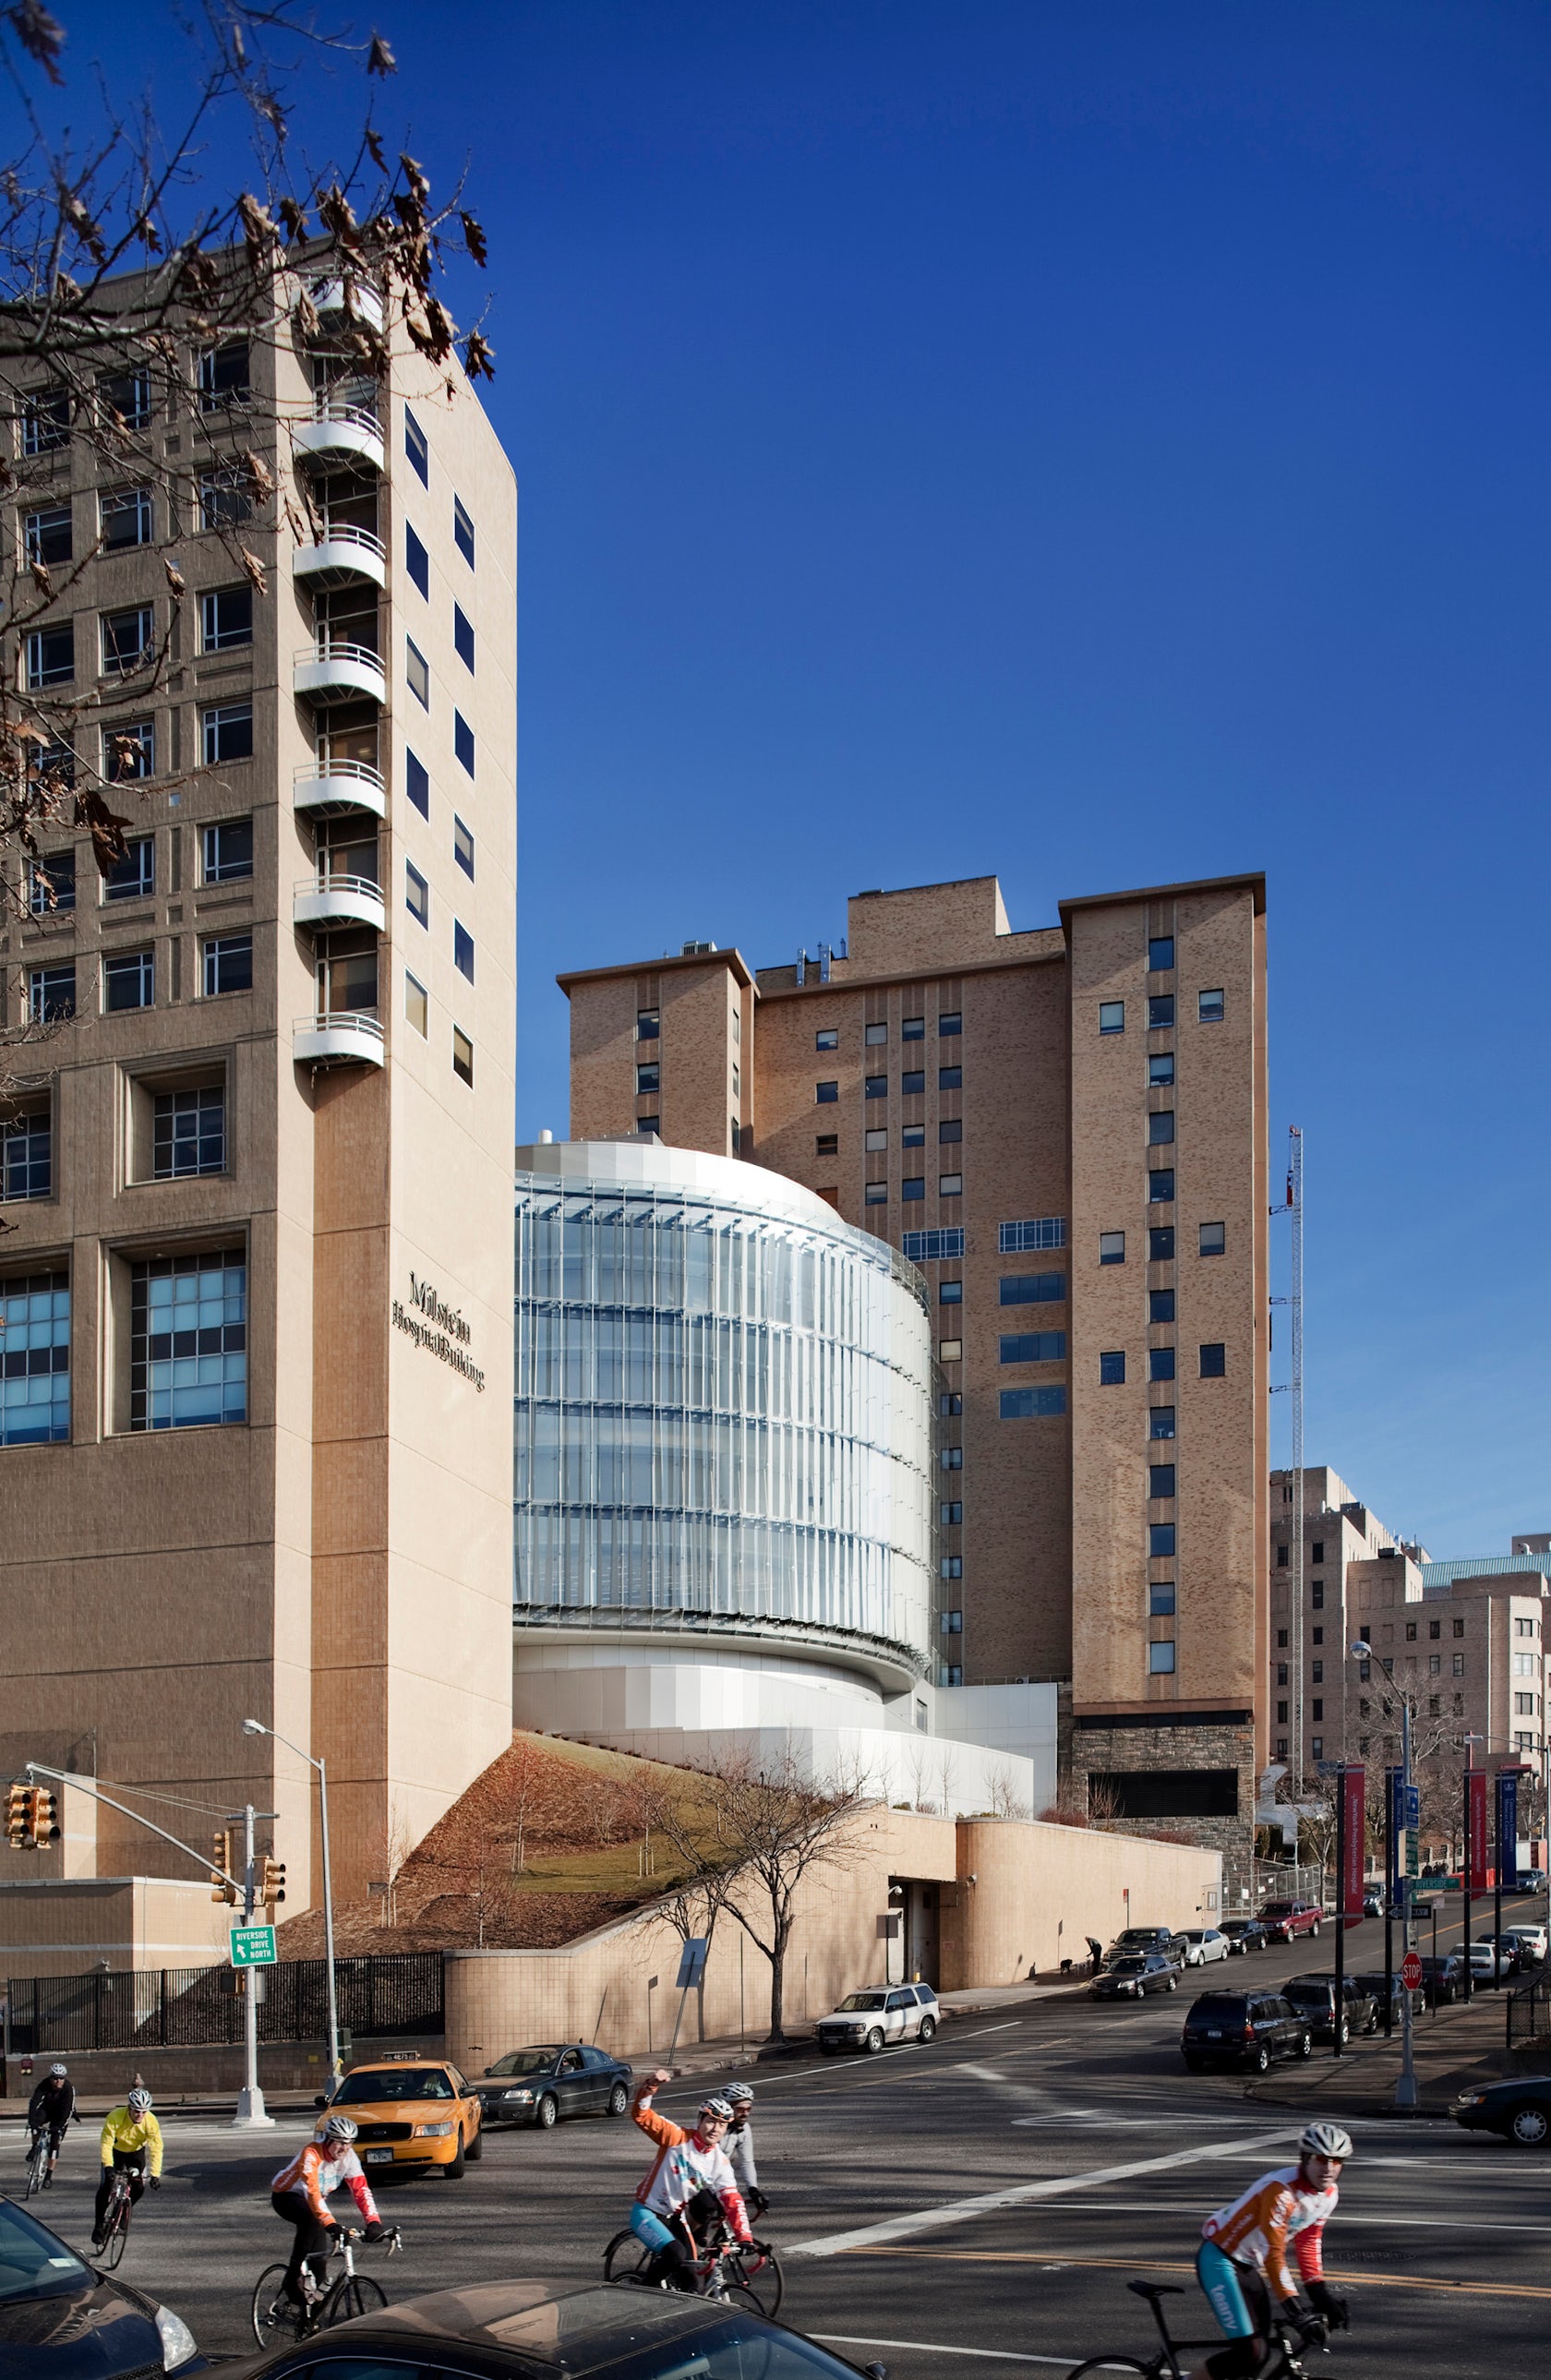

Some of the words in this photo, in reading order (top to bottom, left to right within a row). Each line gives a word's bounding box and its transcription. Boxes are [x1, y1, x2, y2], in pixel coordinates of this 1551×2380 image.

[409, 1270, 471, 1345] Milstein
[392, 1300, 441, 1355] Hospital
[439, 1335, 485, 1393] Building
[1351, 1868, 1359, 1894] Hospital
[1416, 1879, 1448, 1889] RIVERSIDE
[236, 1930, 269, 1941] RIVERSIDE
[250, 1941, 269, 1949] DRIVE
[250, 1950, 271, 1958] NORTH
[1404, 1964, 1420, 1978] STOP
[1210, 2284, 1238, 2330] teany
